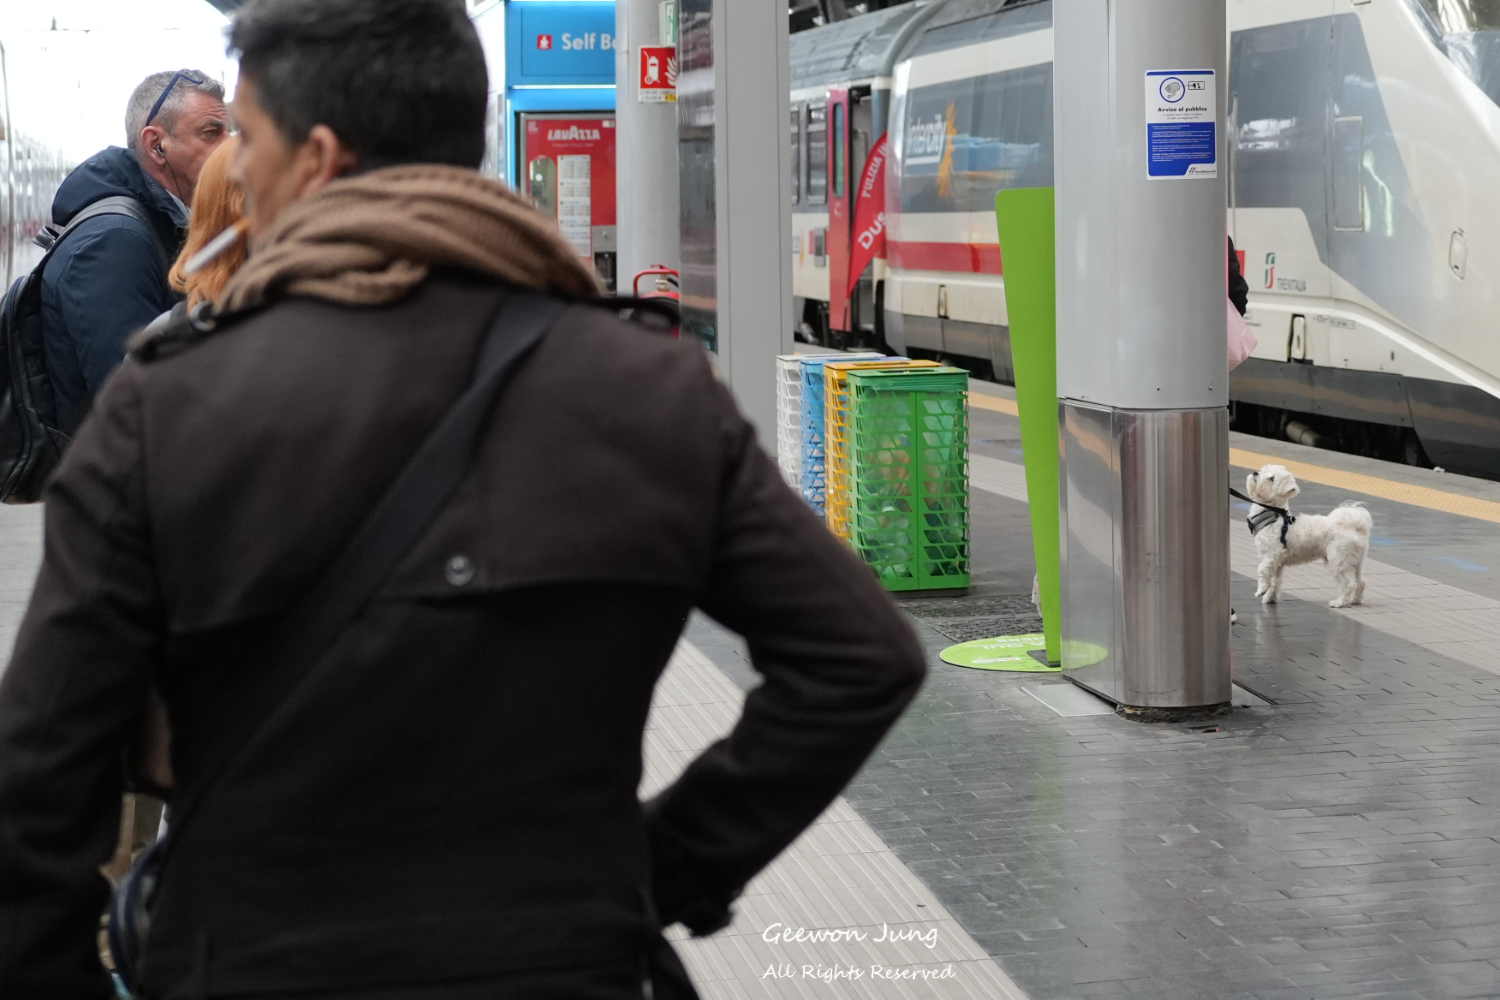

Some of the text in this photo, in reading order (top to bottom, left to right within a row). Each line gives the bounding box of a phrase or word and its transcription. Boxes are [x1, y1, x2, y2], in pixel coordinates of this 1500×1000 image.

[562, 32, 596, 50] Self
[547, 125, 601, 140] LAVAZZA
[861, 156, 883, 198] PULIZIA
